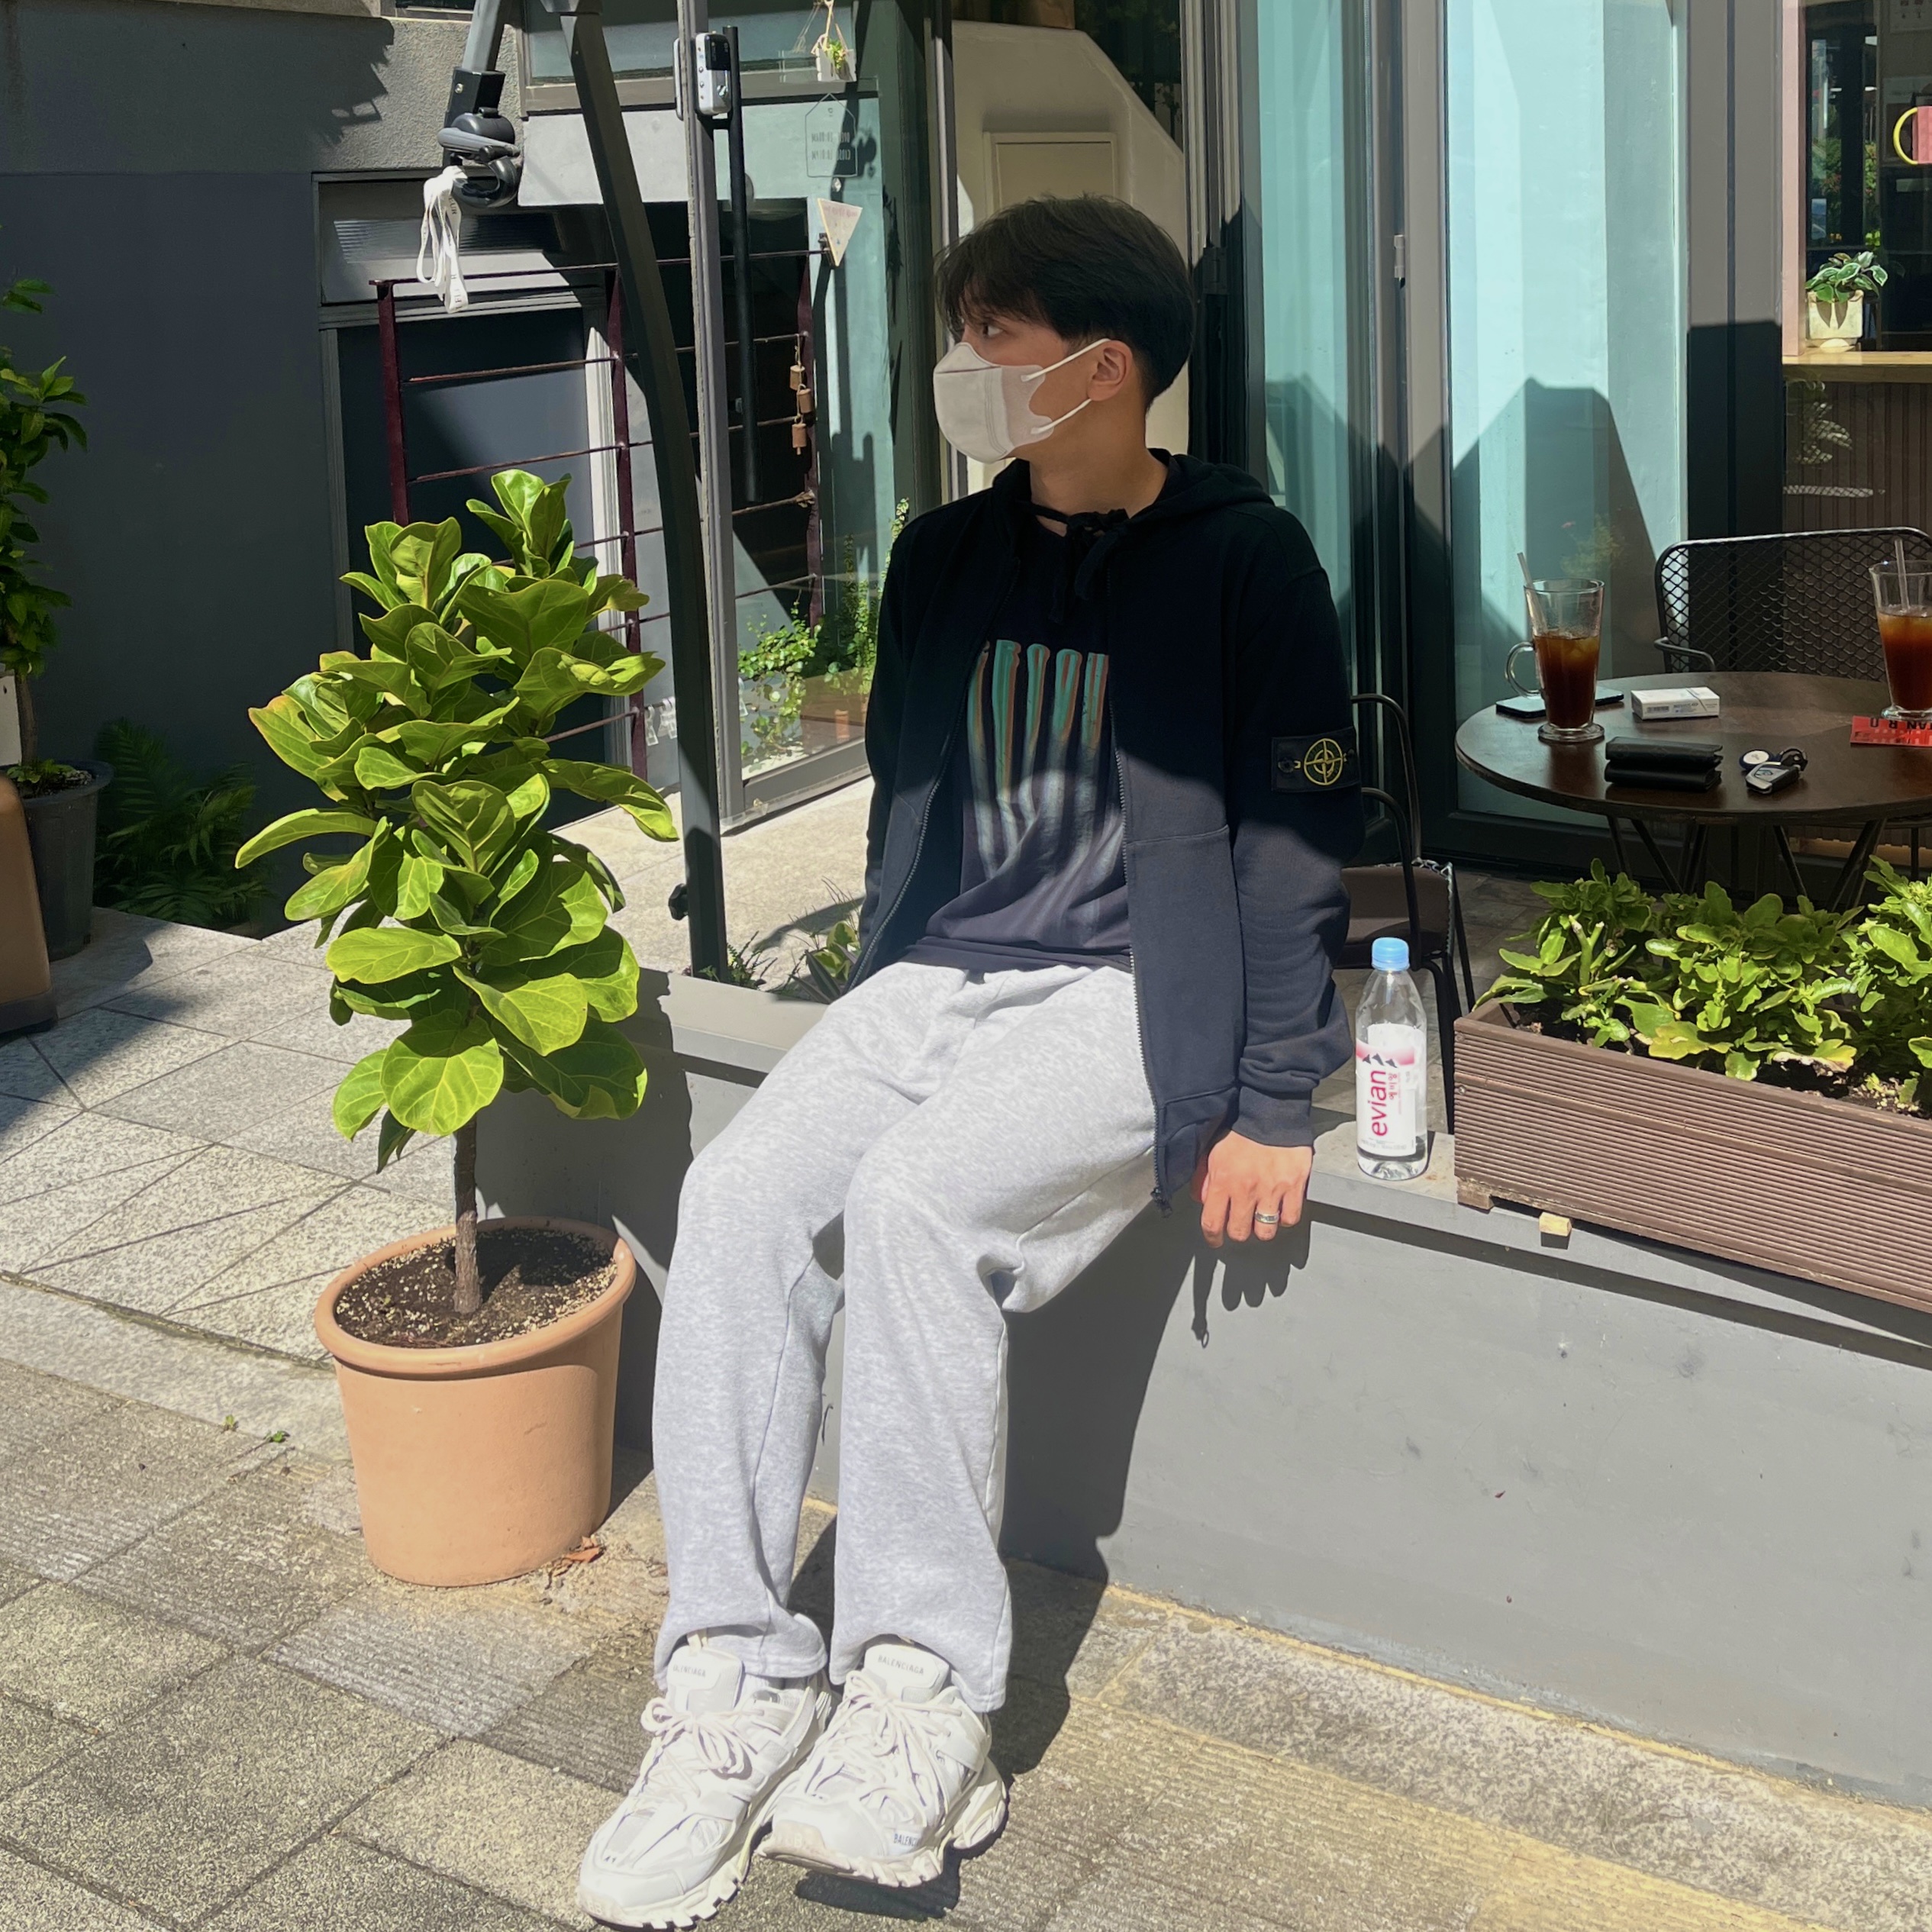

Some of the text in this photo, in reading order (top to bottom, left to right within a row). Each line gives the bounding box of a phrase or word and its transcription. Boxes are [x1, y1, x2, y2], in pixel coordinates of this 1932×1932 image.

[1388, 1072, 1398, 1100] 에비앙
[1367, 1070, 1388, 1137] evian
[878, 1654, 924, 1676] BALENCIAGA
